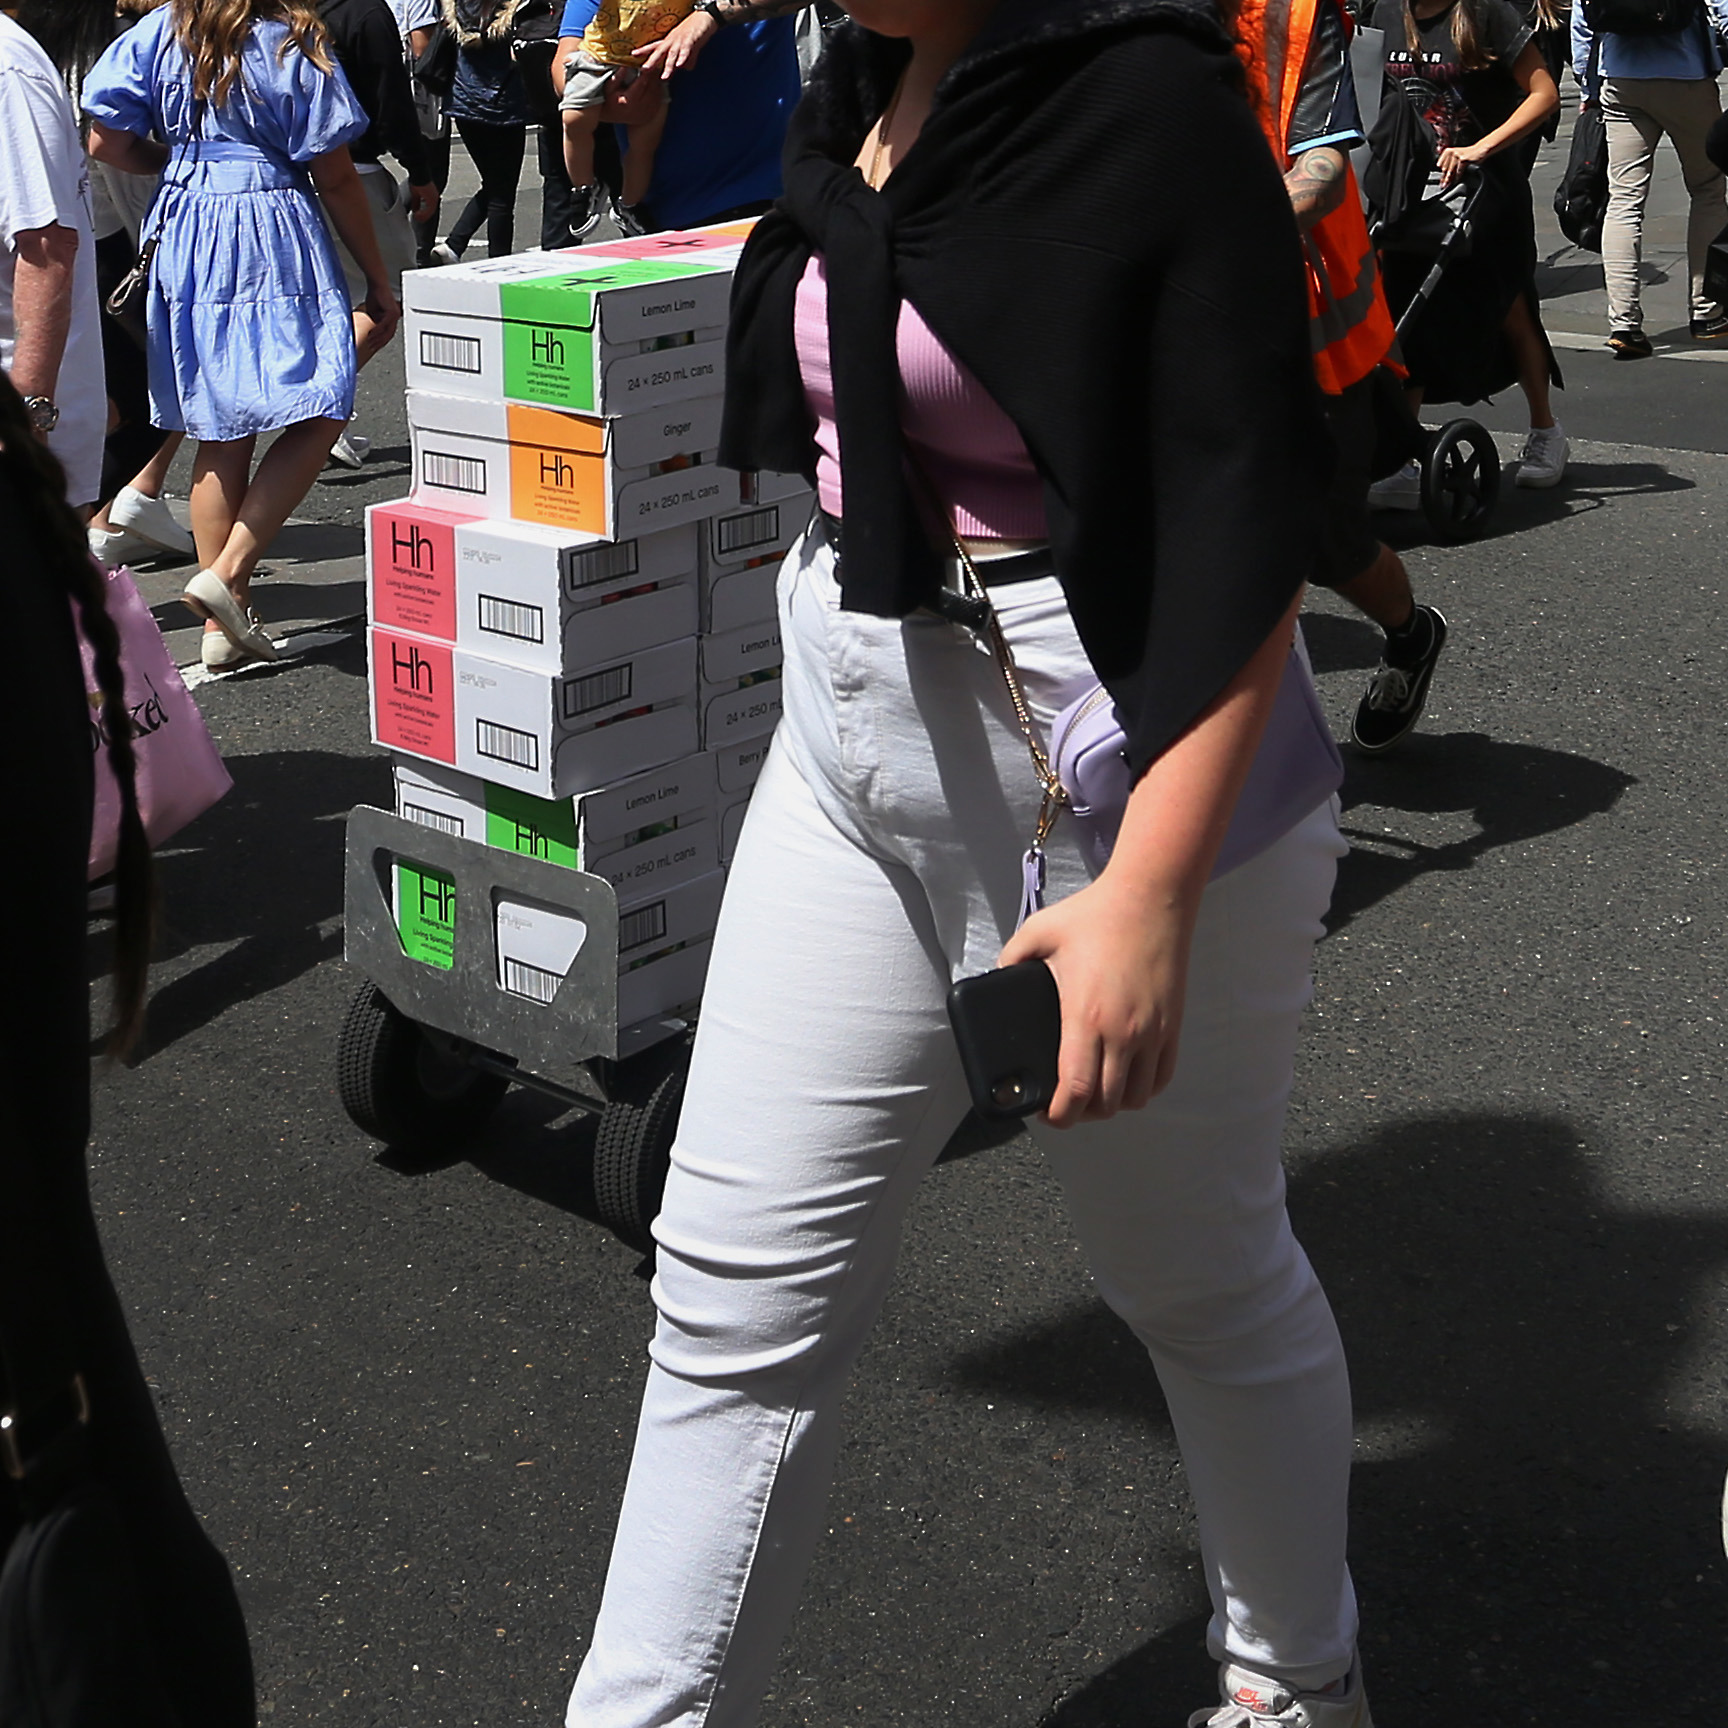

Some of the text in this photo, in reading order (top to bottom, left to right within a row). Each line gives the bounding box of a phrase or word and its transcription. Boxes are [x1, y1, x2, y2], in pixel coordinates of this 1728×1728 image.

[1388, 51, 1442, 63] LUAR
[641, 299, 696, 317] Lemon Lime
[531, 329, 565, 365] Hh
[628, 377, 641, 390] 24
[652, 371, 671, 386] 250
[673, 367, 688, 380] mL
[690, 363, 714, 377] cans
[663, 422, 692, 437] Ginger
[540, 452, 574, 489] Hh
[639, 501, 651, 515] 24
[661, 494, 680, 509] 250
[681, 490, 695, 503] mL
[697, 484, 720, 498] cans
[391, 521, 434, 572] Hh
[741, 639, 770, 654] Lemon
[391, 641, 433, 694] Hh
[726, 713, 739, 726] 24
[749, 702, 768, 719] 250
[739, 752, 760, 767] Berry
[625, 785, 679, 811] Lemon Lime
[515, 819, 548, 859] Hh
[635, 859, 655, 878] 250
[657, 854, 672, 869] mL
[673, 846, 697, 863] cans
